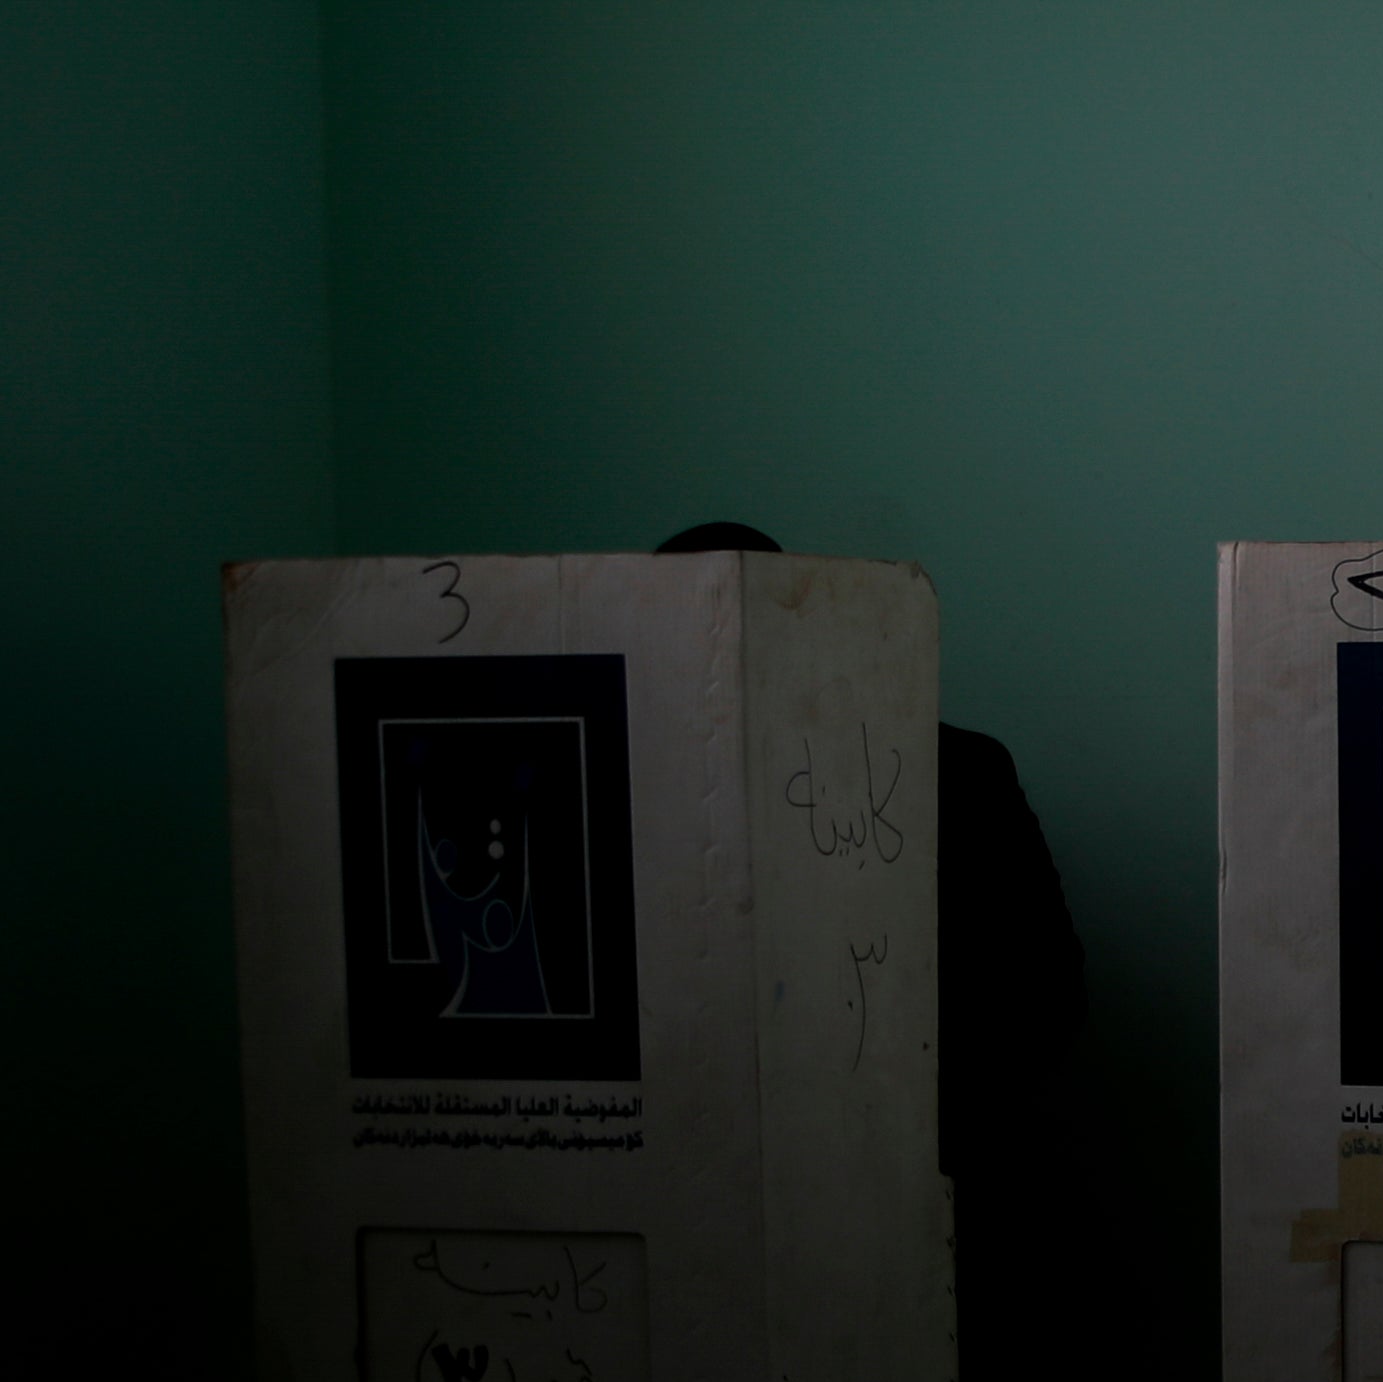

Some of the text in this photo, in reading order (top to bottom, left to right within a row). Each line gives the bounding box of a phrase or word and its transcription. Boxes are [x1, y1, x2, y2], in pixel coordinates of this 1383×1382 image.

[423, 561, 471, 644] 3
[352, 1092, 643, 1122] المفوضية العليا المستقلة للانتخابات
